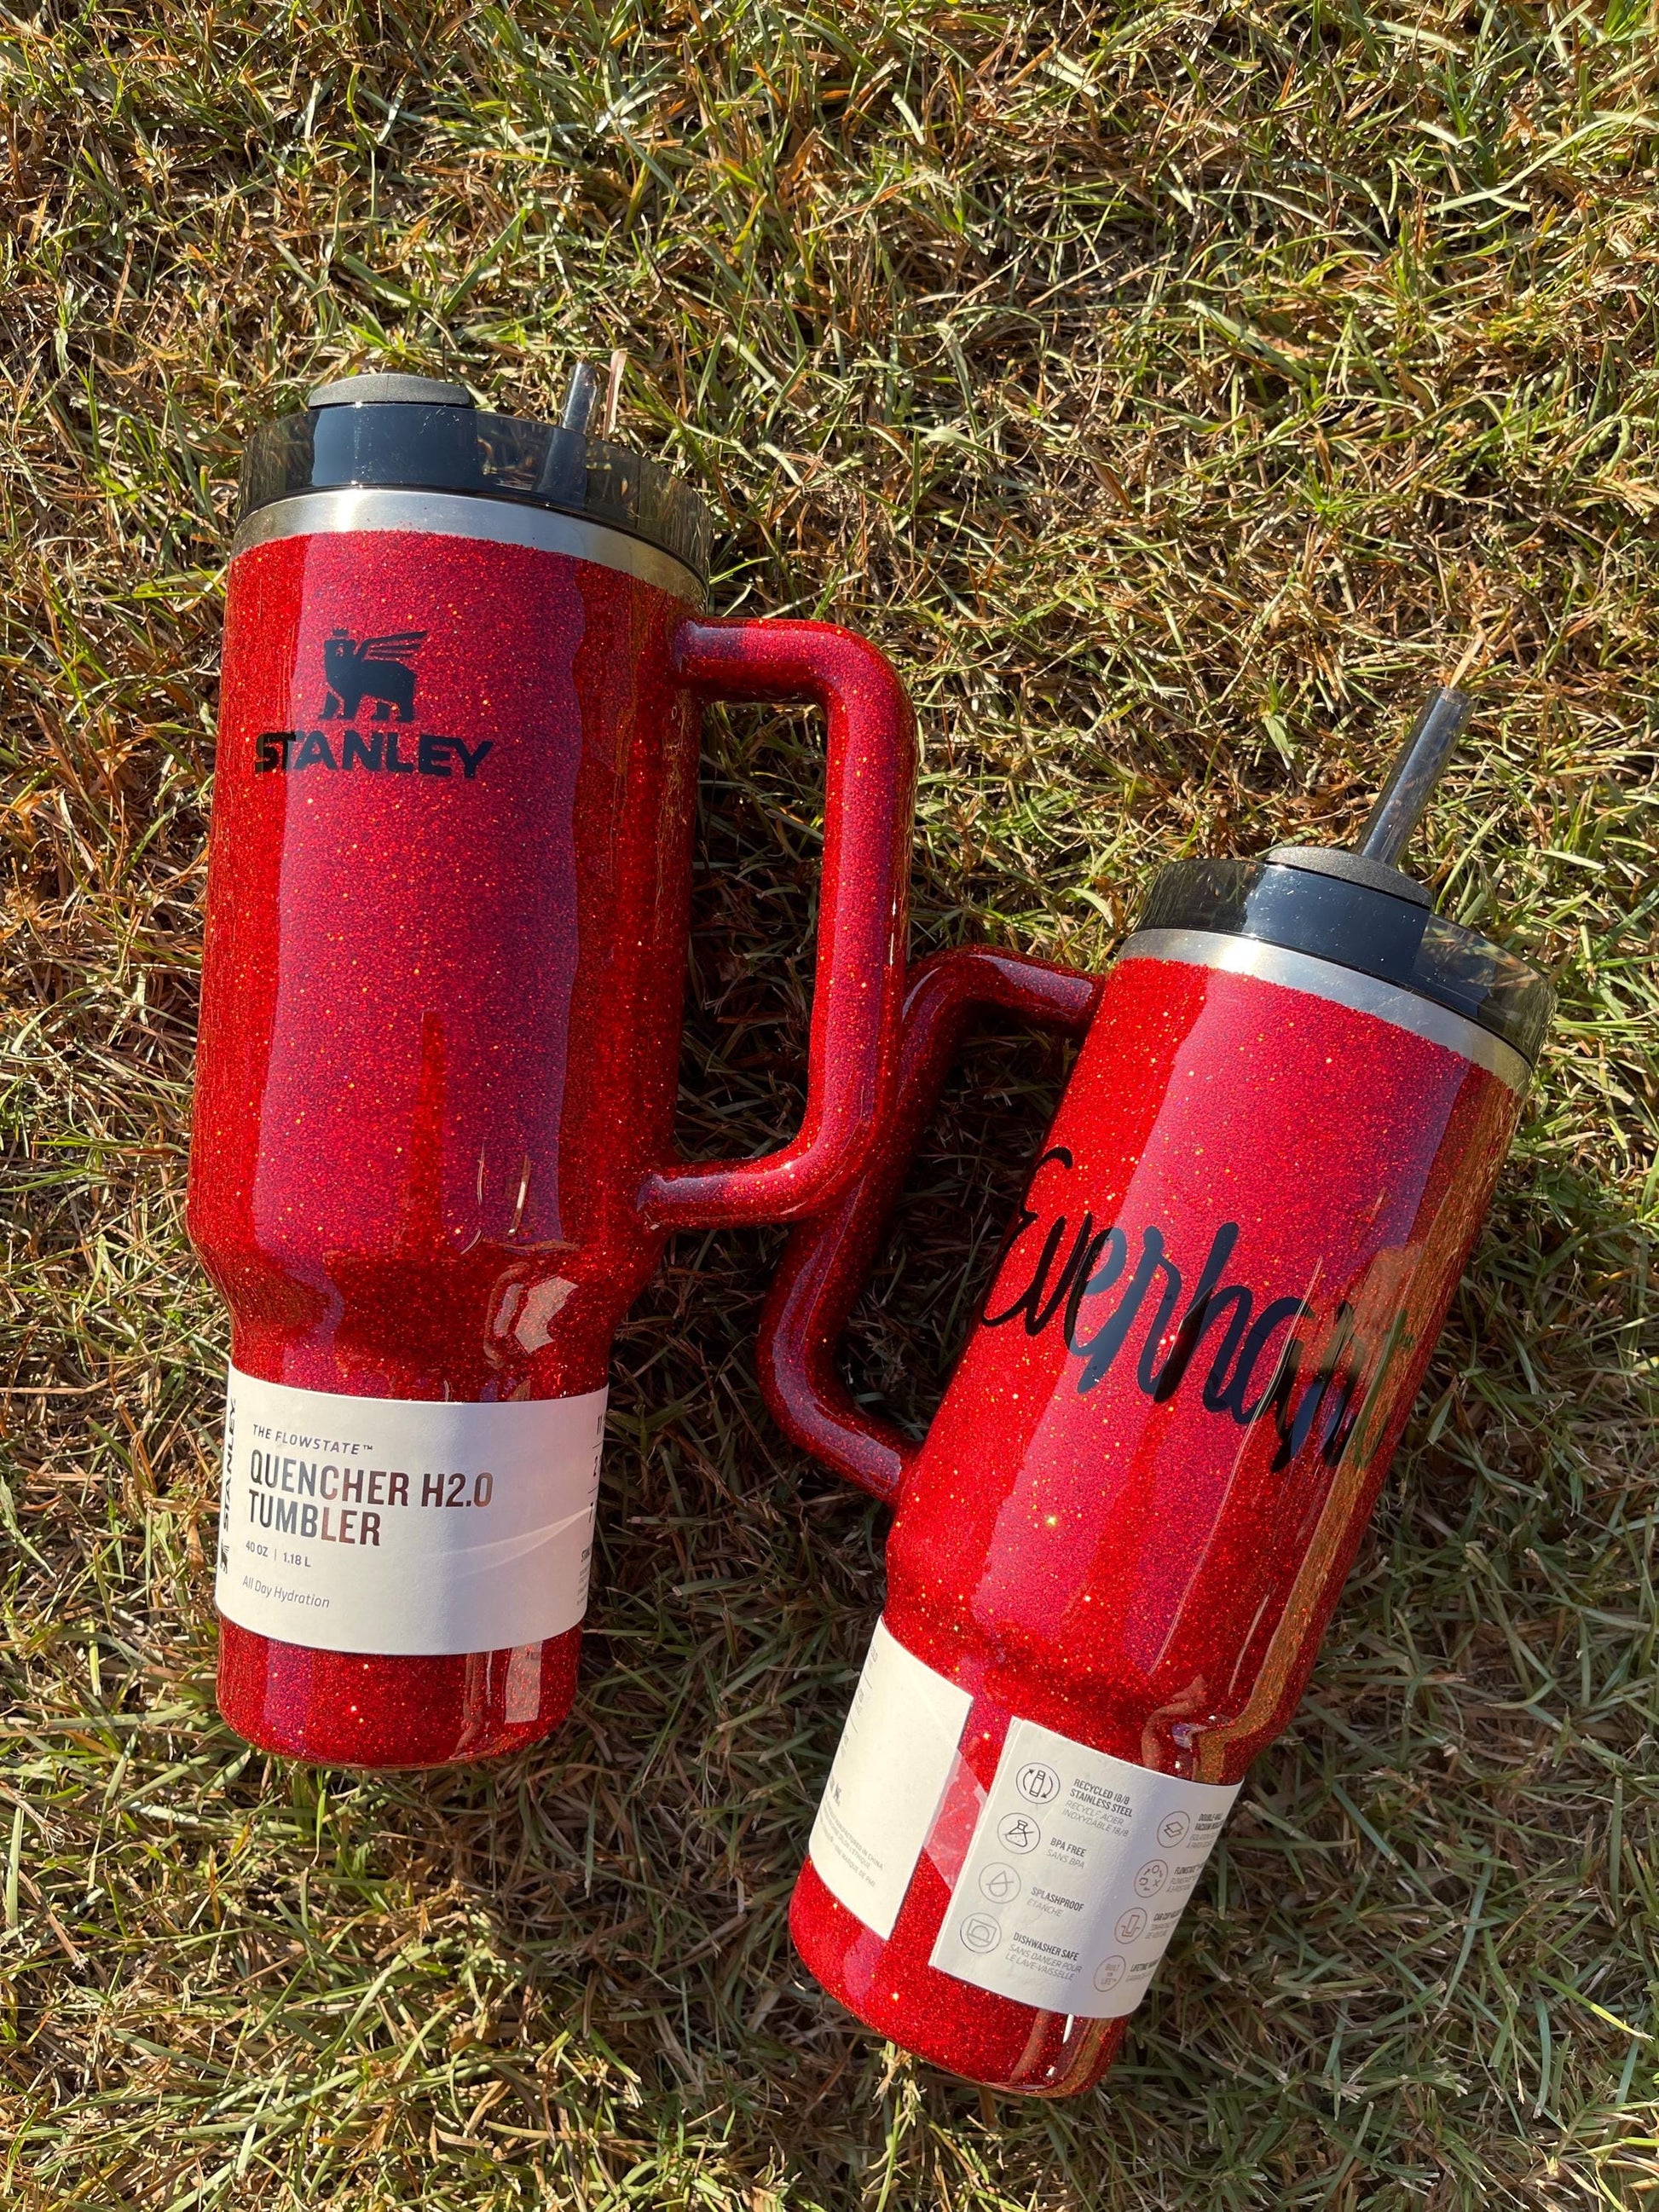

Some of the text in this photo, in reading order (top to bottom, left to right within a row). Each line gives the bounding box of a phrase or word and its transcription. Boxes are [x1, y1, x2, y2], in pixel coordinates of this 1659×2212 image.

[255, 730, 494, 780] STANLEY
[253, 1424, 272, 1440] THE
[223, 1397, 236, 1533] STANLEY
[250, 1448, 409, 1507] QUENCHER
[248, 1488, 381, 1547] TUMBLER
[246, 1539, 269, 1558] 40 OZ
[283, 1551, 311, 1568] 1.18 L
[242, 1574, 331, 1608] All Day Hydration
[1073, 1778, 1113, 1799] RECYCLED
[1070, 1788, 1133, 1817] STAINLESS STEEL
[1062, 1809, 1113, 1832] INOXYDABLE
[1101, 1813, 1124, 1825] ACIER
[1046, 1849, 1085, 1868] SANS BPA
[1050, 1837, 1087, 1857] BPA FREE
[1031, 1886, 1084, 1912] SPLASHPROOF
[1009, 1943, 1031, 1957] SANS
[1062, 1961, 1083, 1973] POUR
[1013, 1932, 1080, 1961] DISHWASHER SAFE
